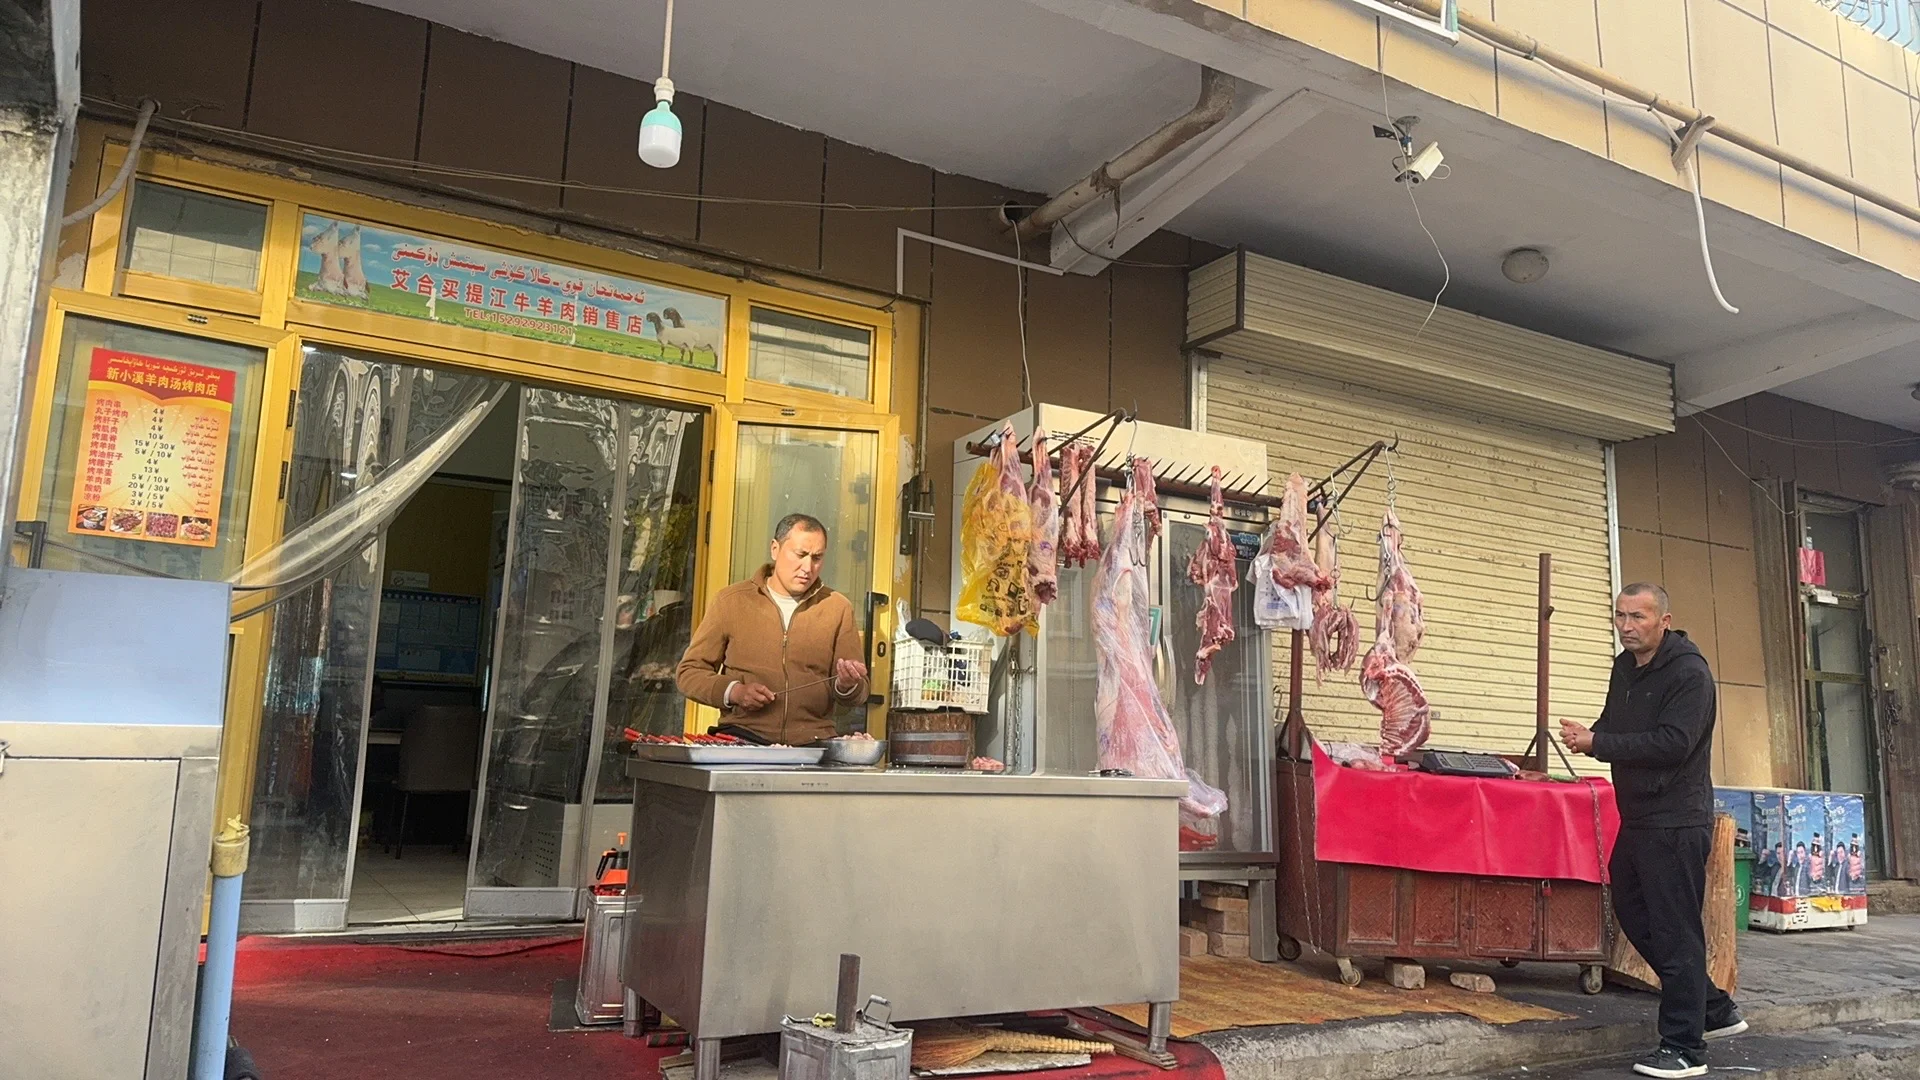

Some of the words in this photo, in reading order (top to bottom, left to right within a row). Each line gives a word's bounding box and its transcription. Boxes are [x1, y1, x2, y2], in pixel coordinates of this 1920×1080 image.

[390, 268, 643, 335] 艾合买提江牛羊肉销售店
[106, 366, 218, 397] 新小溪羊肉汤烤肉店
